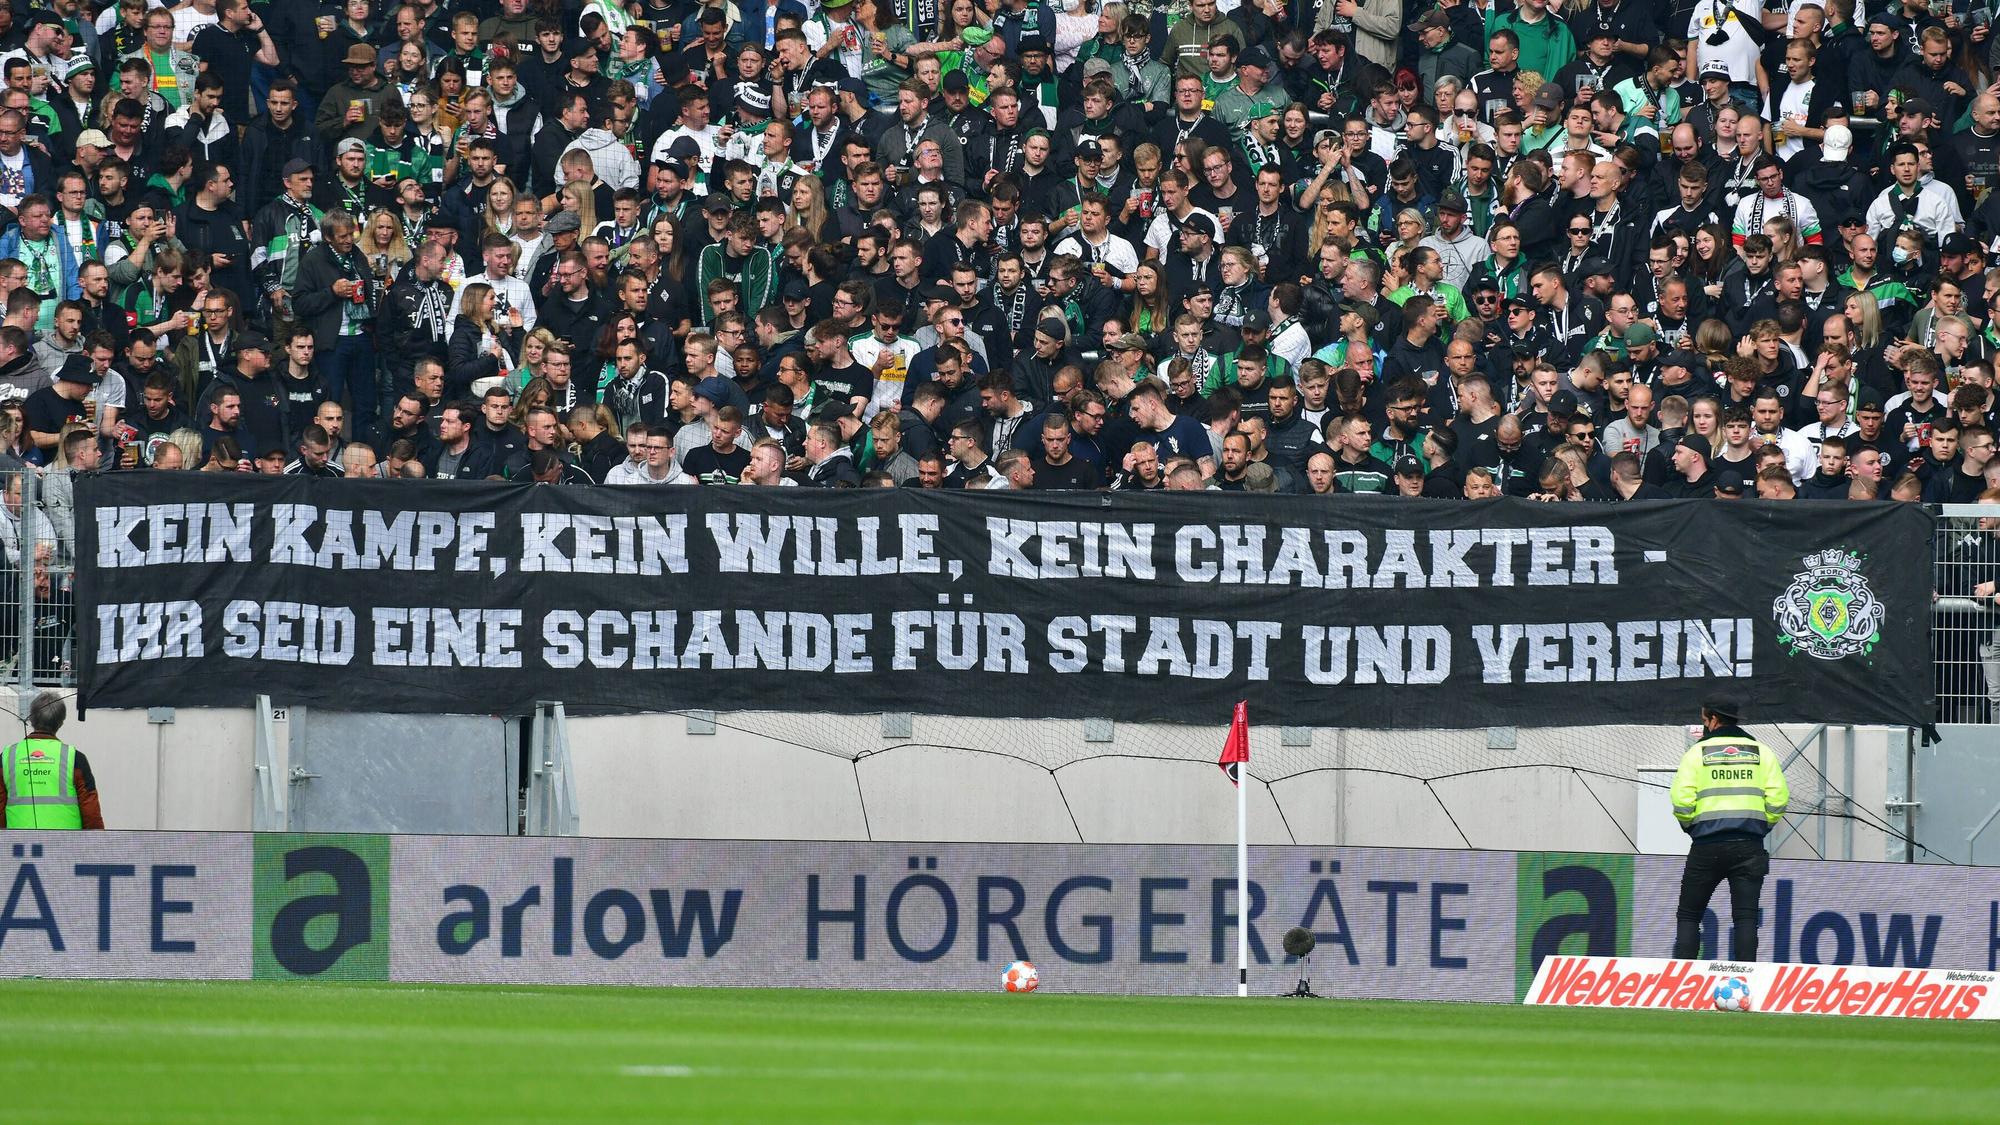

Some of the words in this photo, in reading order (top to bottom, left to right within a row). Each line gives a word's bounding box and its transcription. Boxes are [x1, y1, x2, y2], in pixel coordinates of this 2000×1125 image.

[96, 503, 254, 567] KEIN
[271, 504, 506, 580] KAMPF,
[520, 513, 689, 575] KEIN
[706, 513, 963, 581] WILLE,
[986, 516, 1155, 579] KEIN
[1175, 526, 1618, 589] CHARAKTER
[1820, 568, 1844, 576] NORD
[97, 600, 204, 664] IHR
[222, 600, 356, 665] SEID
[372, 607, 523, 668] EINE
[542, 609, 873, 673] SCHANDE
[891, 593, 1029, 674] FÜR
[1047, 615, 1282, 681] STADT
[1302, 625, 1452, 685] UND
[1472, 618, 1753, 684] VEREIN!
[274, 710, 286, 719] 21
[1712, 770, 1753, 779] ORDNER
[436, 857, 743, 960] arlow
[806, 856, 1470, 969] HÖRGERÄTE
[1537, 959, 1748, 1008] WeberHau
[1761, 966, 1988, 1019] WeberHaus
[1946, 971, 1995, 982] WeberHaus.de
